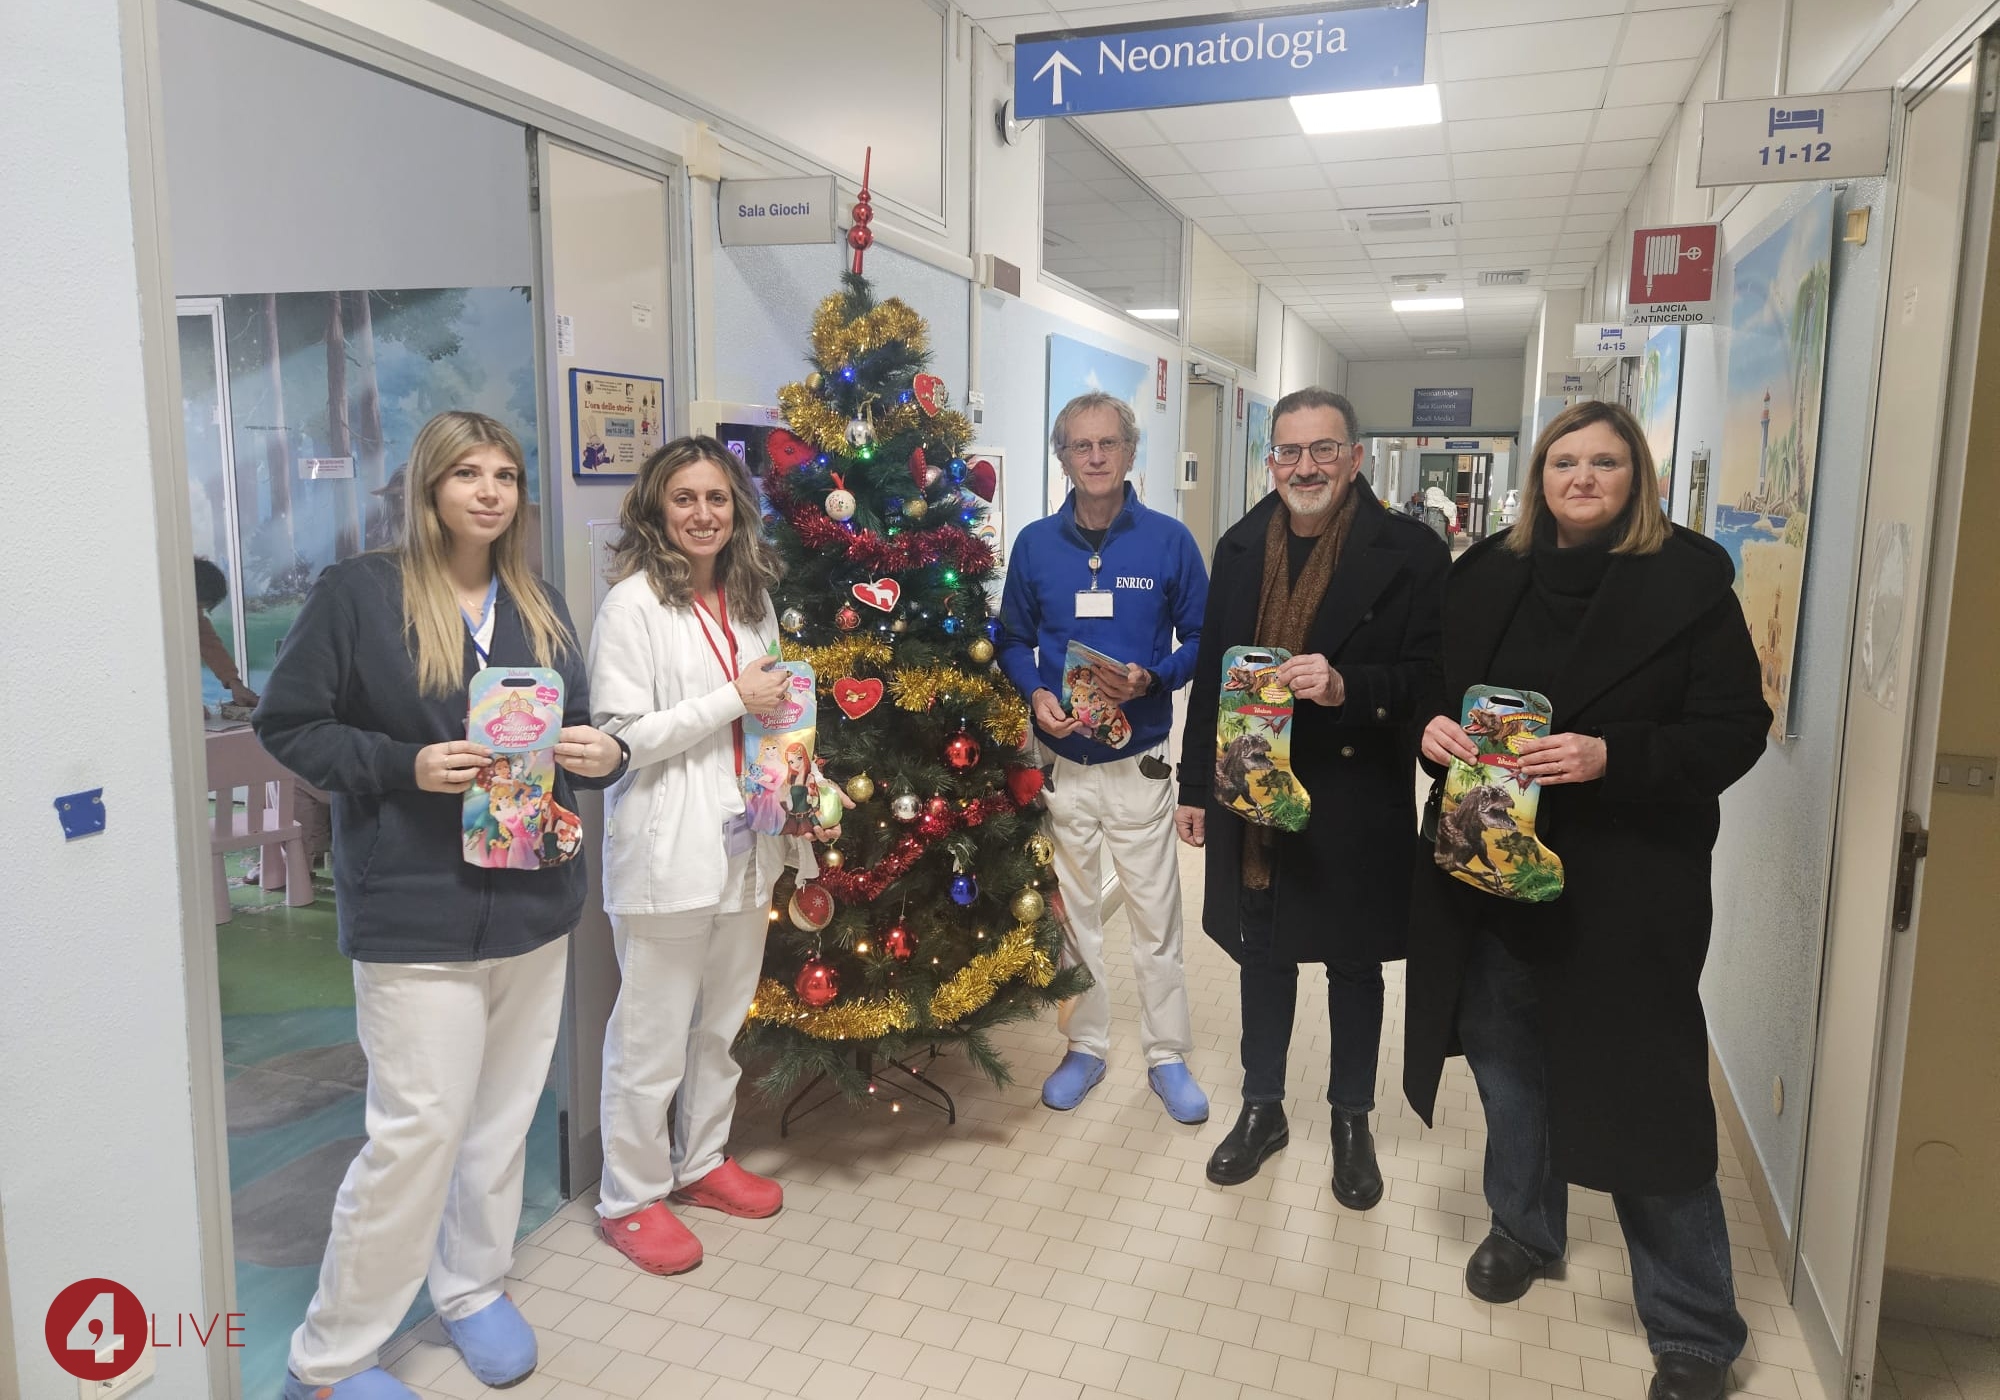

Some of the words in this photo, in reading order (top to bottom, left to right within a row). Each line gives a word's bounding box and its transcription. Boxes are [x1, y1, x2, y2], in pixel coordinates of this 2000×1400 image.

[1098, 18, 1348, 75] Neonatologia
[1759, 142, 1832, 165] 11-12
[738, 204, 766, 218] Sala
[769, 202, 810, 216] Giochi
[1650, 304, 1688, 313] LANCIA
[1596, 342, 1626, 352] 14-15
[584, 400, 600, 409] L'ora
[601, 401, 616, 411] delle
[616, 403, 633, 413] storie
[1115, 576, 1154, 590] ENRICO
